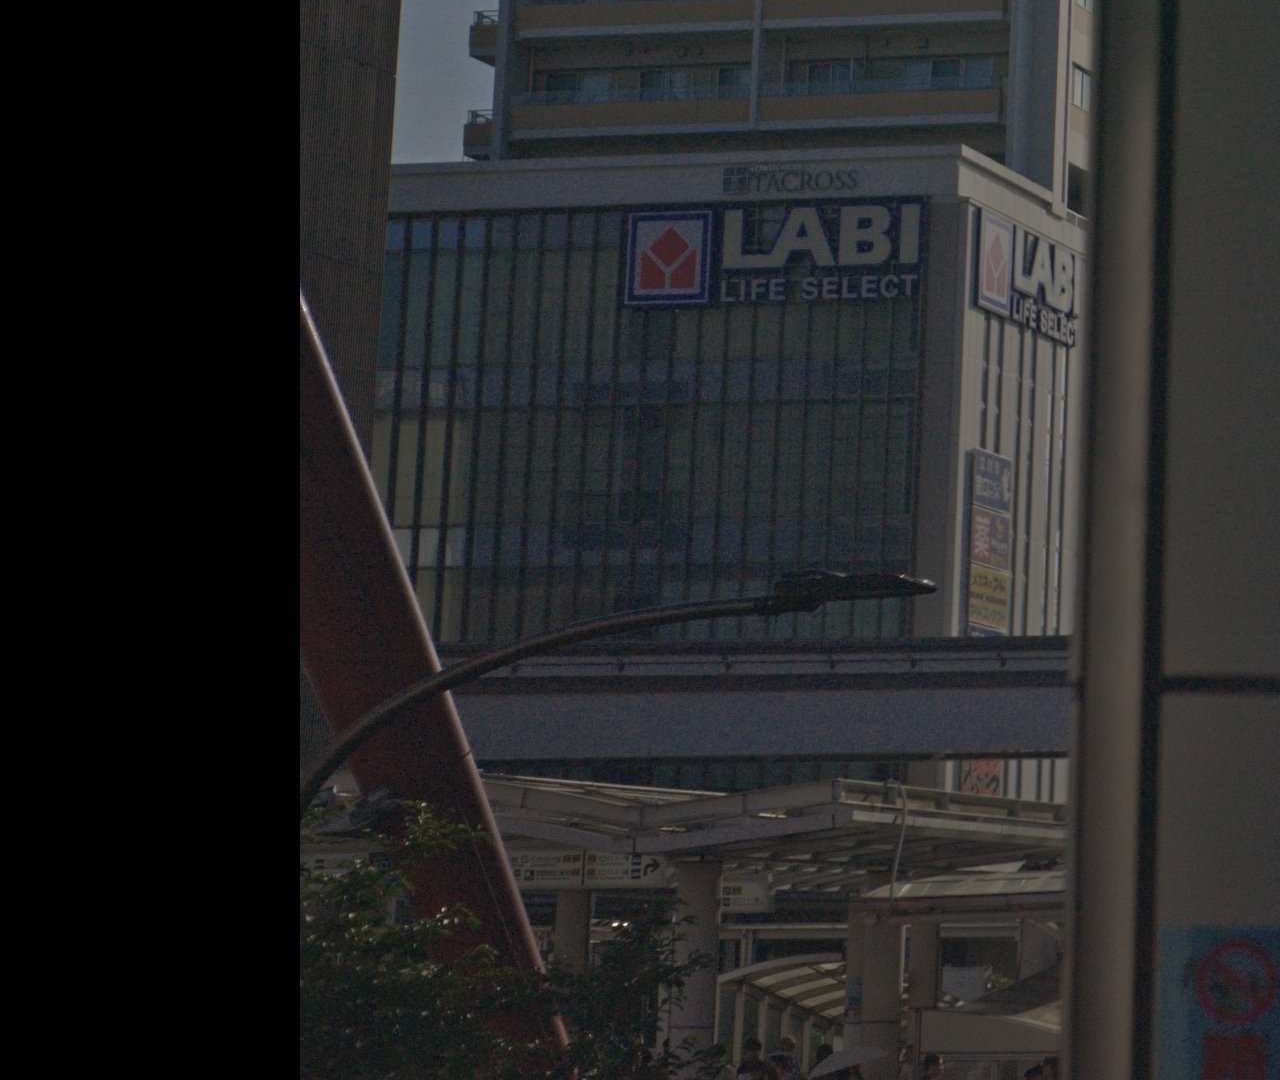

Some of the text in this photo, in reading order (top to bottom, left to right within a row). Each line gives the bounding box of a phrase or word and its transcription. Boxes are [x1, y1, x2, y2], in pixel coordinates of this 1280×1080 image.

[752, 171, 858, 193] TACROSS
[723, 205, 921, 269] LABI
[720, 273, 918, 302] LIFE SELECT
[1012, 294, 1037, 328] LIFE
